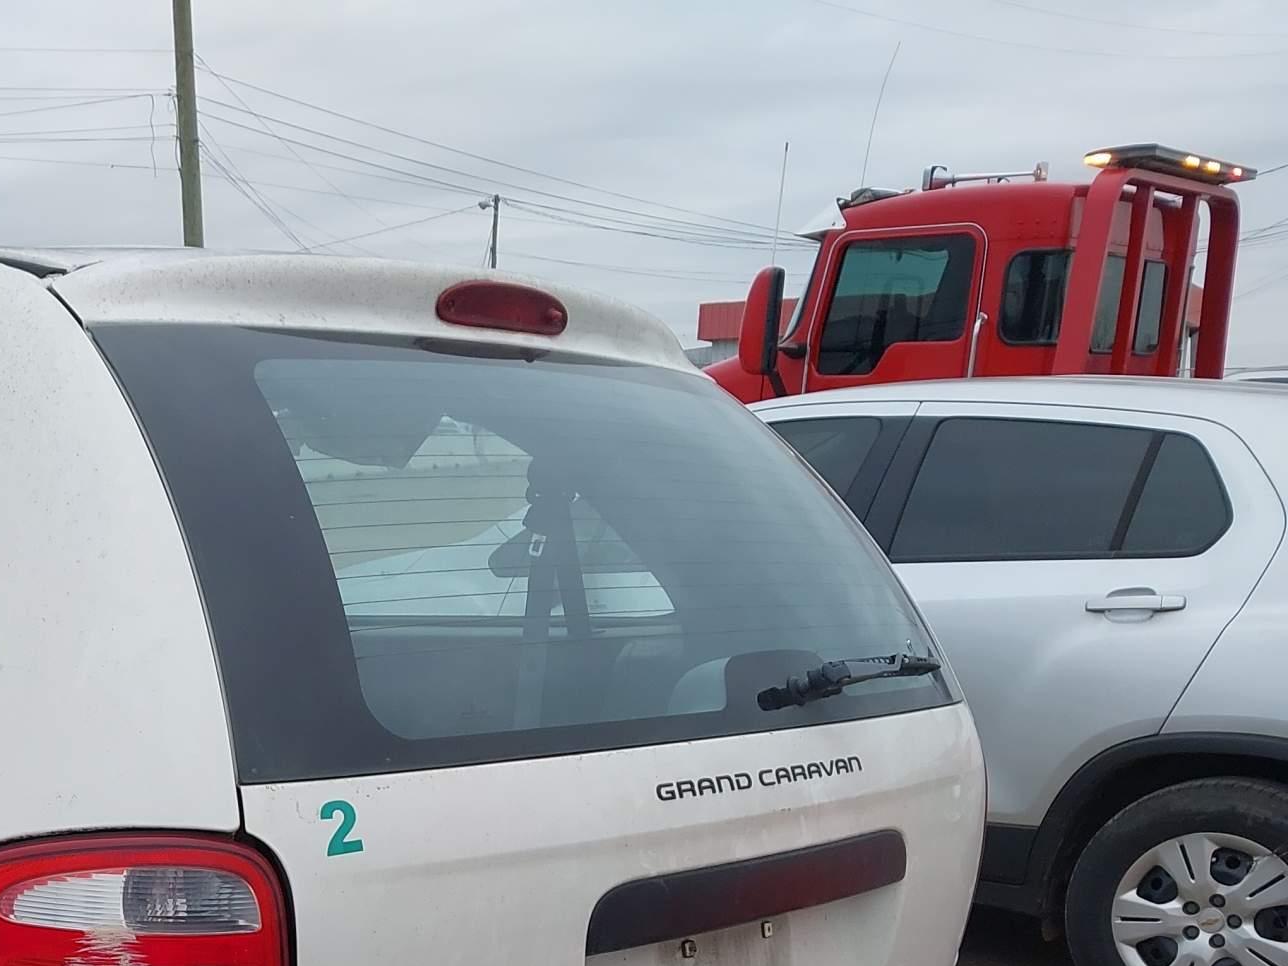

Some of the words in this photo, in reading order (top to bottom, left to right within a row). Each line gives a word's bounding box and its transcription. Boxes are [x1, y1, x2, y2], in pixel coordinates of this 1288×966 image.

[655, 772, 753, 802] GRAND
[758, 755, 863, 787] CARAVAN
[320, 800, 364, 857] 2
